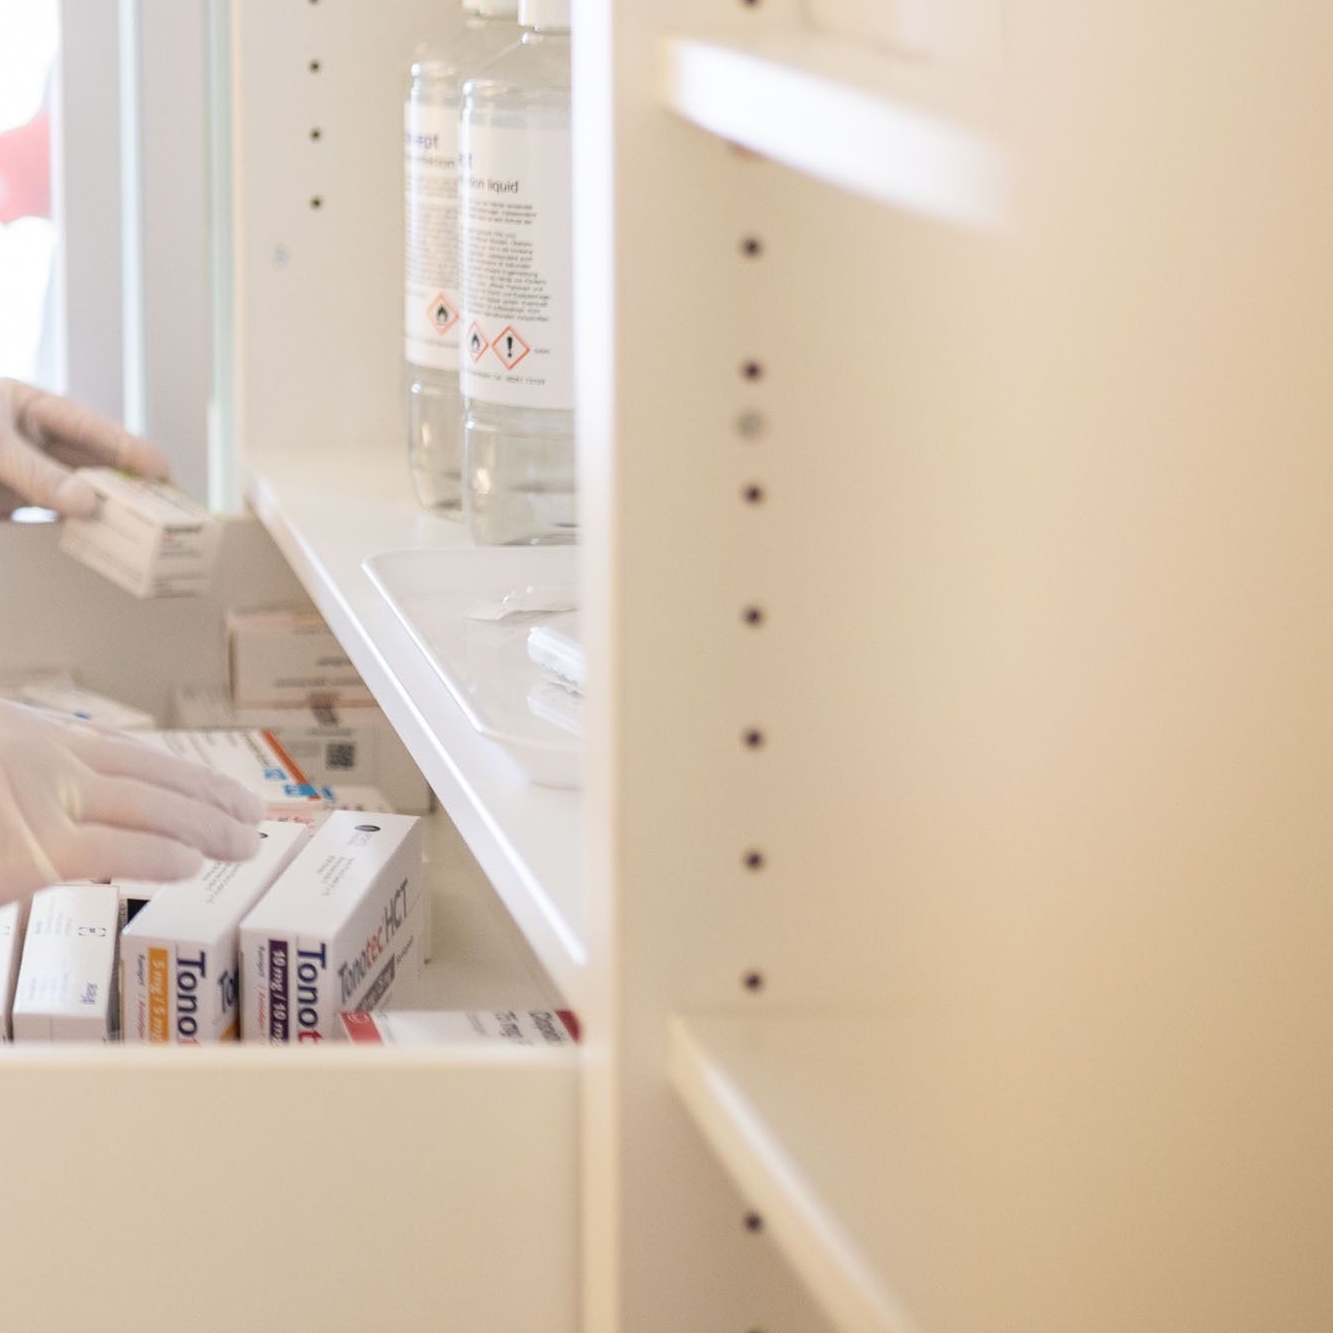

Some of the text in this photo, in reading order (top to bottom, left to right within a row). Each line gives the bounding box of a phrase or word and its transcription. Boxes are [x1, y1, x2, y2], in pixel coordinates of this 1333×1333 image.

[487, 180, 520, 195] liquid
[384, 876, 409, 944] HCT
[272, 949, 286, 967] 10
[269, 967, 283, 991] mg
[272, 1002, 286, 1020] 10
